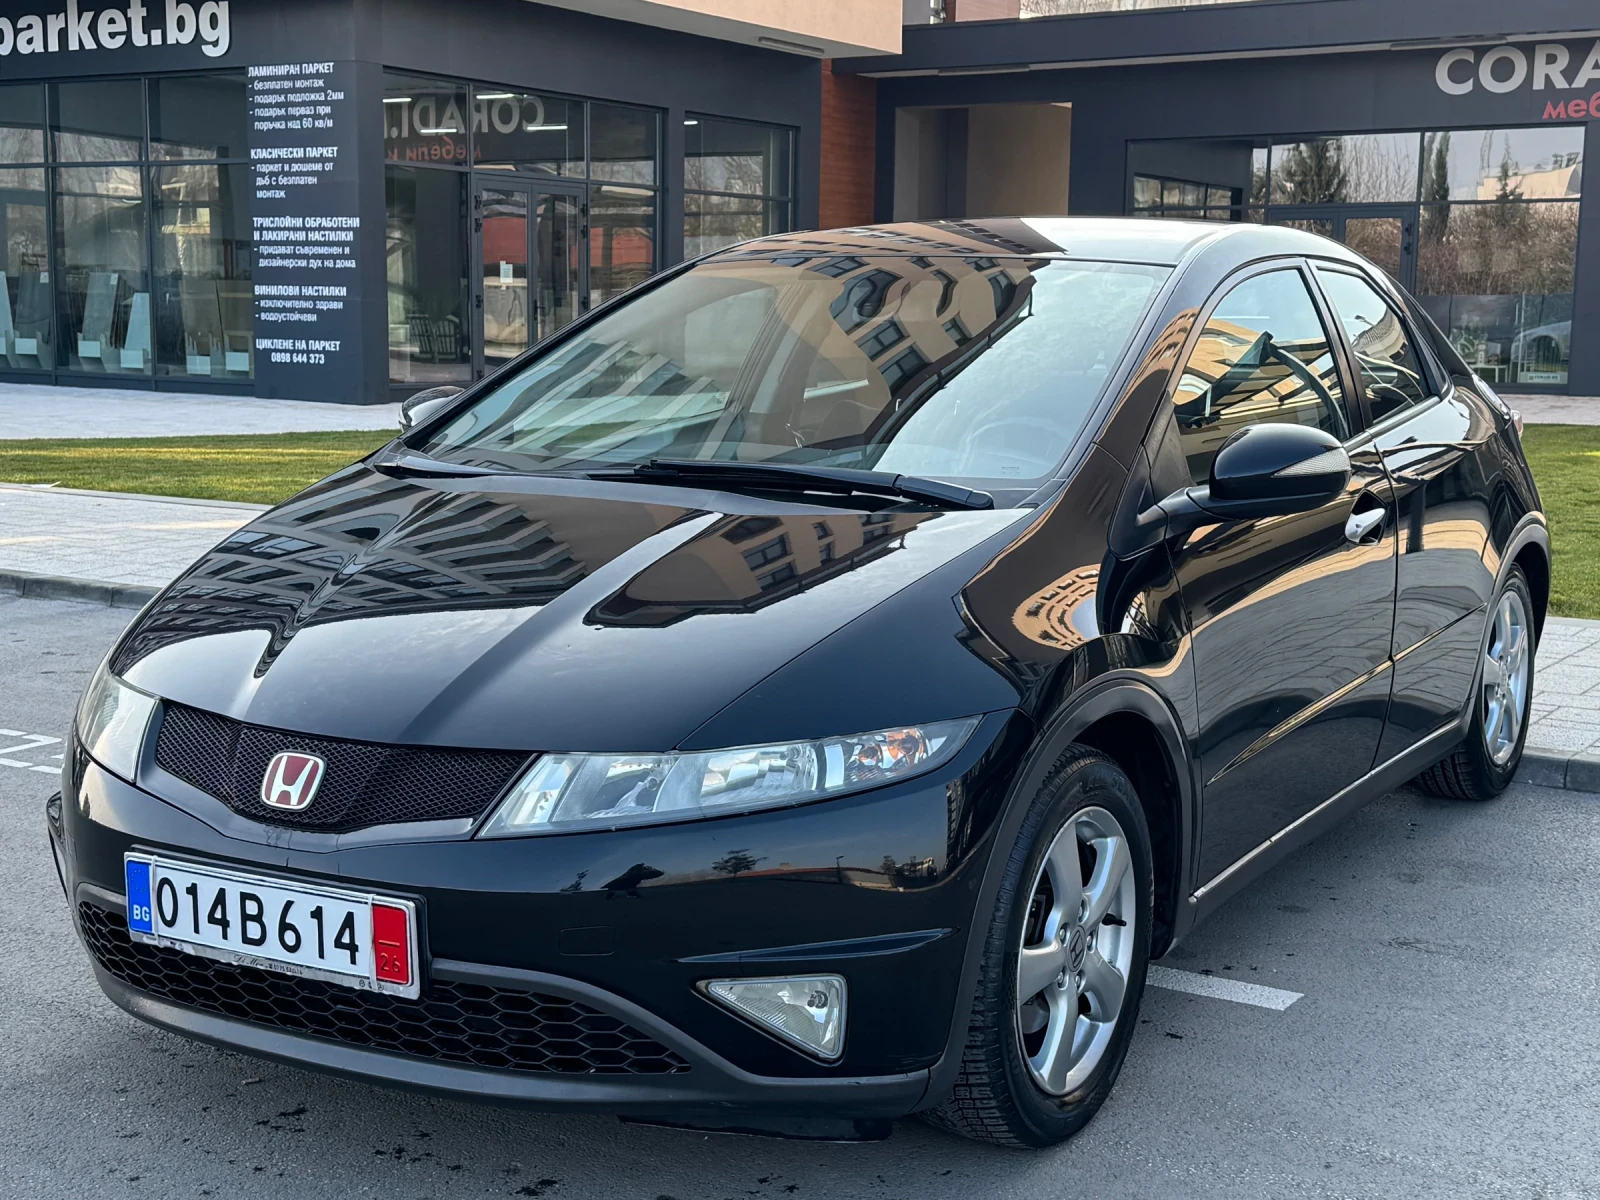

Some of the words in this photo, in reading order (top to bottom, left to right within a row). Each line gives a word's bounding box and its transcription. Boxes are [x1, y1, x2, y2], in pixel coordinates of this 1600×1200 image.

[247, 64, 300, 77] ЛАМИНИРАН
[302, 62, 335, 75] ПАРКЕТ
[253, 80, 293, 91] безплатен
[294, 79, 324, 89] монтаж
[254, 94, 286, 105] подарък
[287, 92, 325, 102] подложка
[326, 89, 345, 101] 2мм
[254, 107, 286, 118] подарък
[287, 106, 314, 117] перваз
[316, 105, 331, 116] при
[254, 120, 286, 132] поръчка
[287, 119, 301, 129] над
[302, 117, 313, 128] 60
[314, 117, 333, 129] кв/м
[250, 147, 304, 159] КЛАСИЧЕСКИ
[306, 146, 338, 158] ПАРКЕТ
[256, 163, 282, 174] паркет
[284, 163, 289, 172] и
[290, 162, 323, 172] дюшеме
[324, 162, 334, 171] от
[256, 175, 270, 186] дъб
[271, 177, 276, 185] с
[278, 175, 317, 185] безплатен
[256, 190, 286, 198] монтаж
[252, 216, 303, 228] ТРИСЛОЙНИ
[304, 216, 360, 228] ОБРАБОТЕНИ
[253, 230, 260, 240] И
[261, 230, 306, 241] ЛАКИРАНИ
[307, 230, 354, 241] НАСТИЛКИ
[259, 245, 295, 256] придават
[295, 246, 342, 256] съвременен
[344, 246, 350, 254] и
[259, 257, 307, 269] дизайнерски
[308, 259, 323, 269] дух
[324, 259, 334, 268] на
[335, 259, 356, 268] дома
[254, 285, 300, 296] ВИНИЛОВИ
[301, 285, 347, 297] НАСТИЛКИ
[260, 299, 314, 309] изключително
[315, 300, 343, 311] здрави
[255, 338, 294, 350] ЦИКЛЕНЕ
[295, 339, 307, 350] НА
[308, 340, 341, 351] ПАРКЕТ
[270, 352, 291, 363] 0898
[292, 352, 308, 363] 644
[309, 353, 325, 364] 373
[132, 903, 151, 923] BG
[156, 876, 360, 966] 014B614
[380, 952, 401, 973] 26
